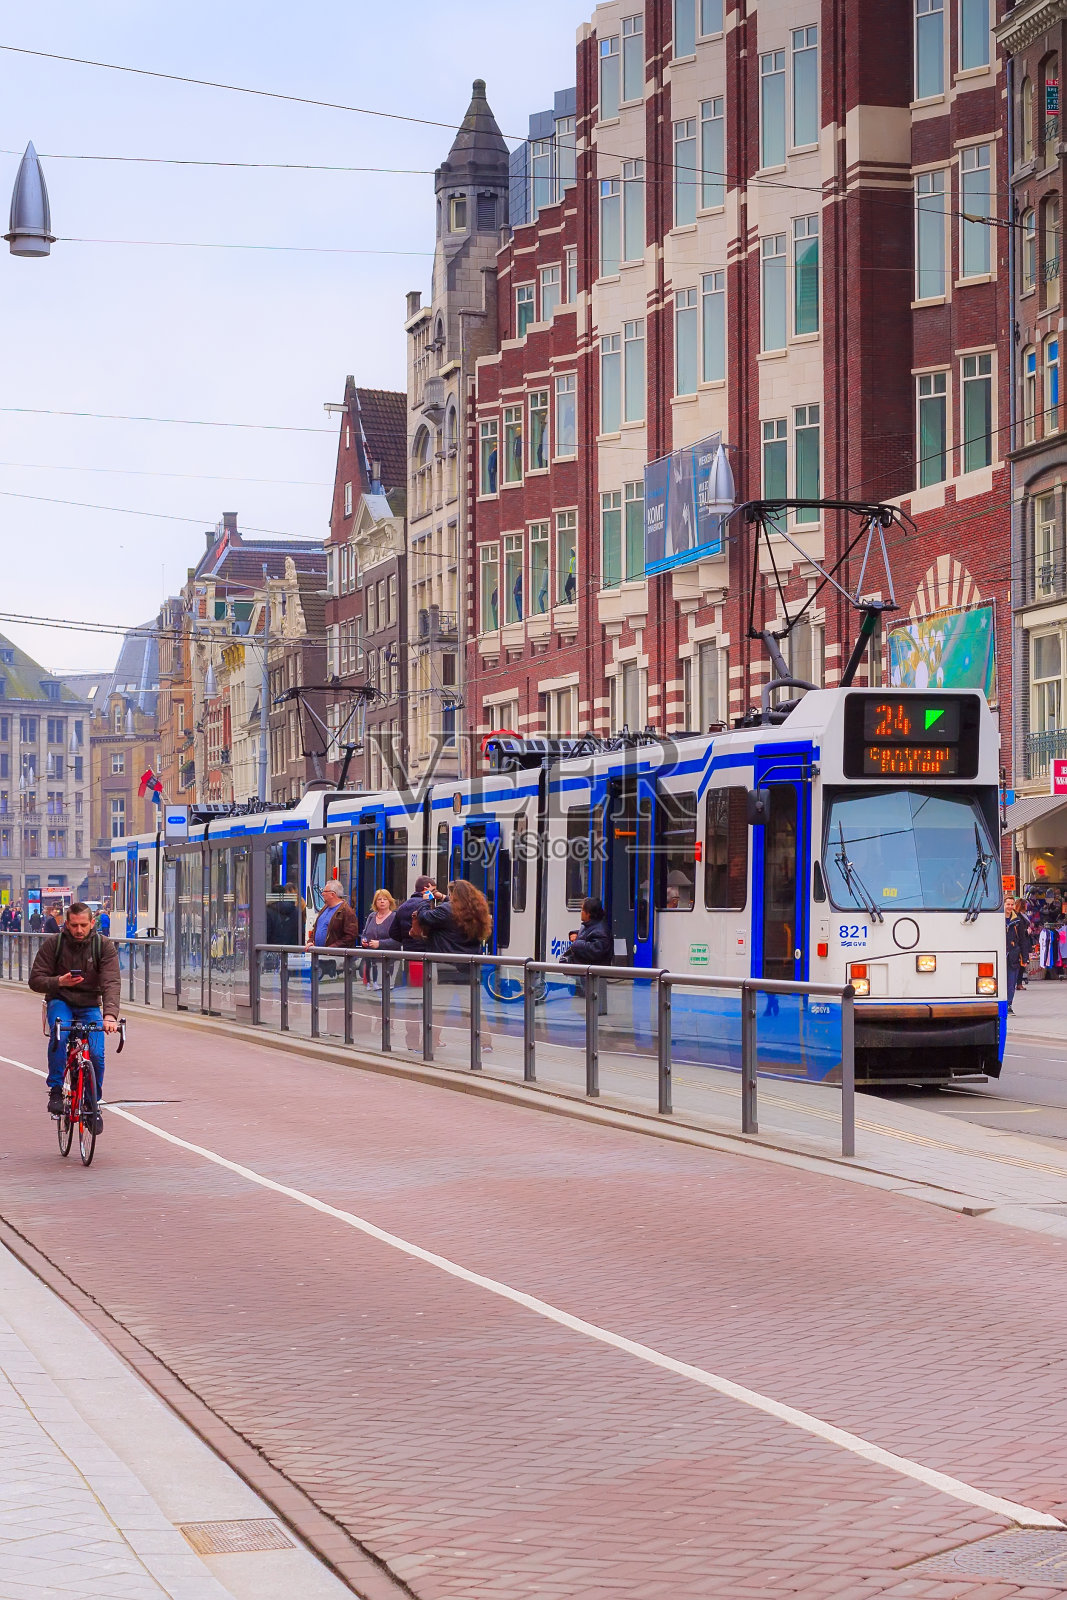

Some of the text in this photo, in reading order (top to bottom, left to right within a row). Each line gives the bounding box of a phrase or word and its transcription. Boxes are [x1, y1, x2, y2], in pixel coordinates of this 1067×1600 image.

[647, 503, 664, 525] KOMT
[875, 705, 911, 735] 24
[869, 747, 950, 760] Centraal
[881, 760, 940, 772] Station
[839, 925, 868, 939] 821
